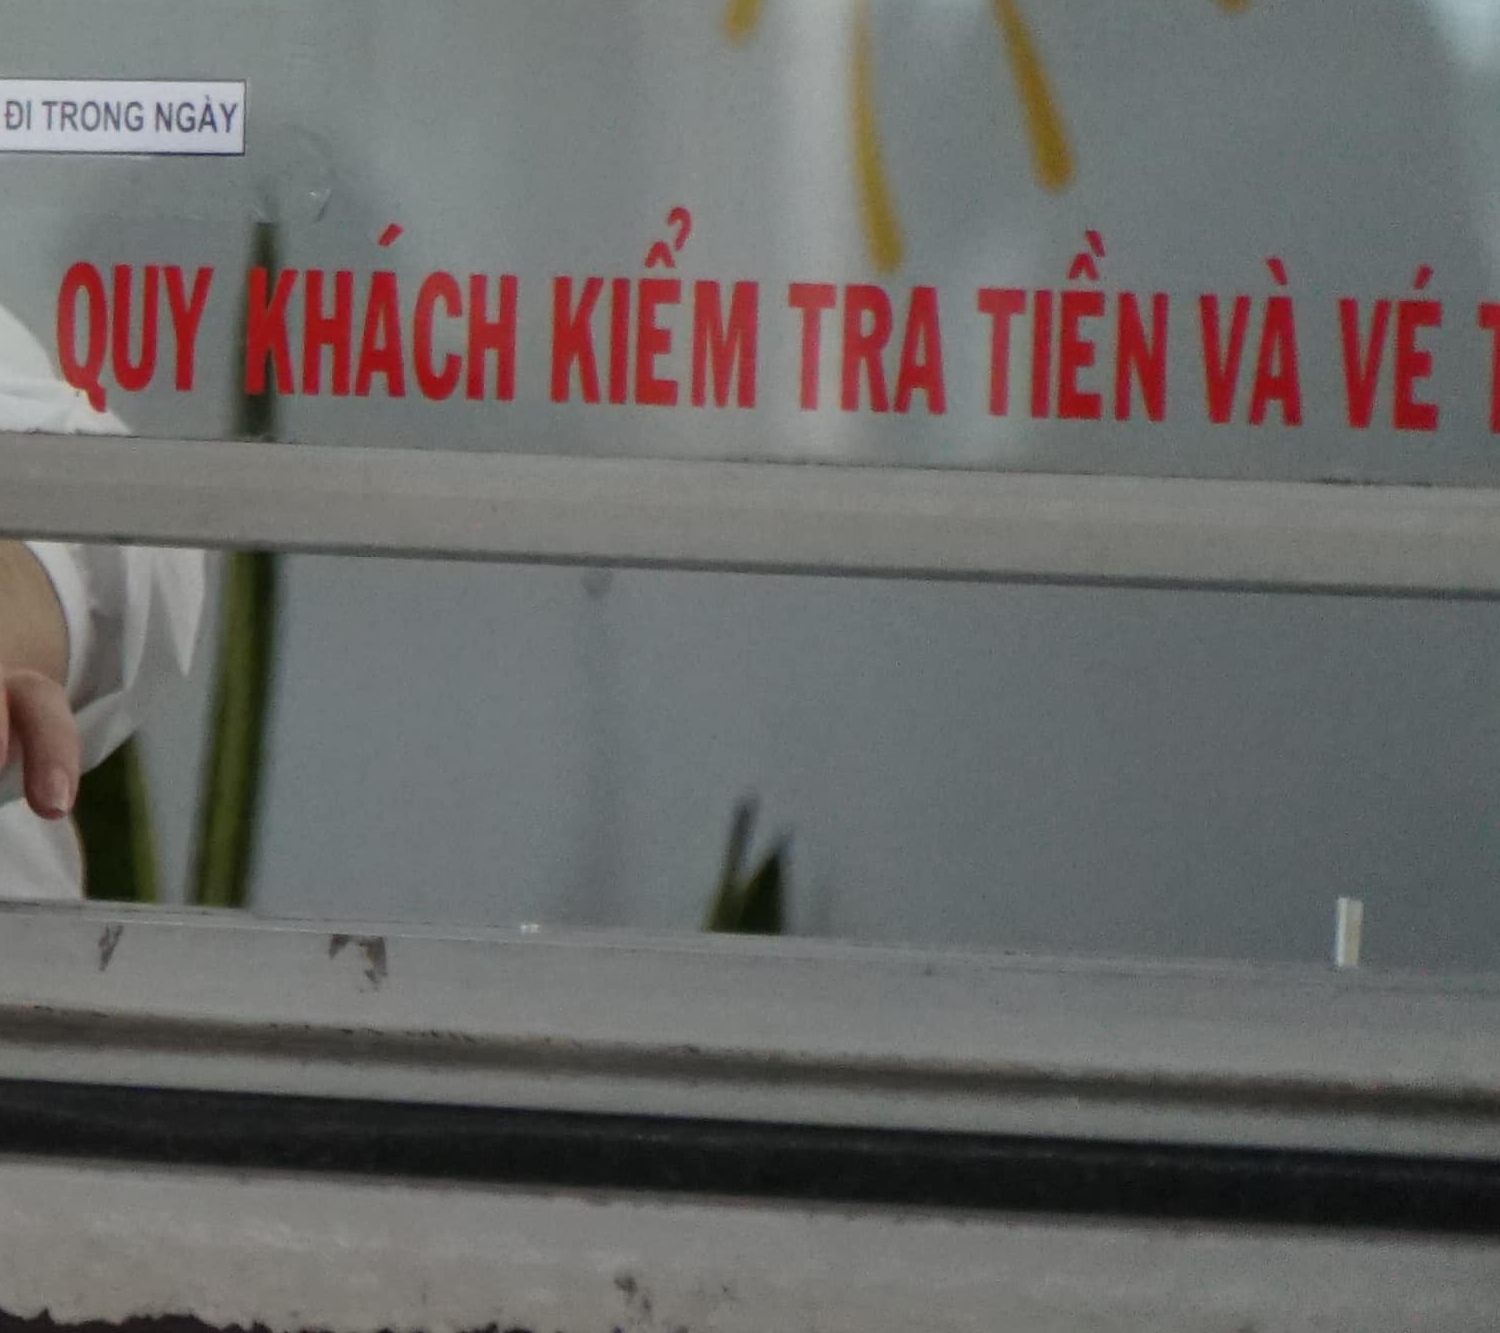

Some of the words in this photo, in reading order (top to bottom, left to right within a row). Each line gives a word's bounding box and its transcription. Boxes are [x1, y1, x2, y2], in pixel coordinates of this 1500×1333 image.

[4, 99, 32, 131] ĐI
[42, 100, 145, 132] TRONG
[155, 94, 238, 134] NGÀY
[244, 223, 519, 402] KHÁCH
[550, 206, 761, 409] KIỂM
[788, 281, 947, 415] TRA
[978, 229, 1169, 422] TIỀN
[1199, 257, 1304, 427] VÀ
[1338, 265, 1442, 432] VÉ
